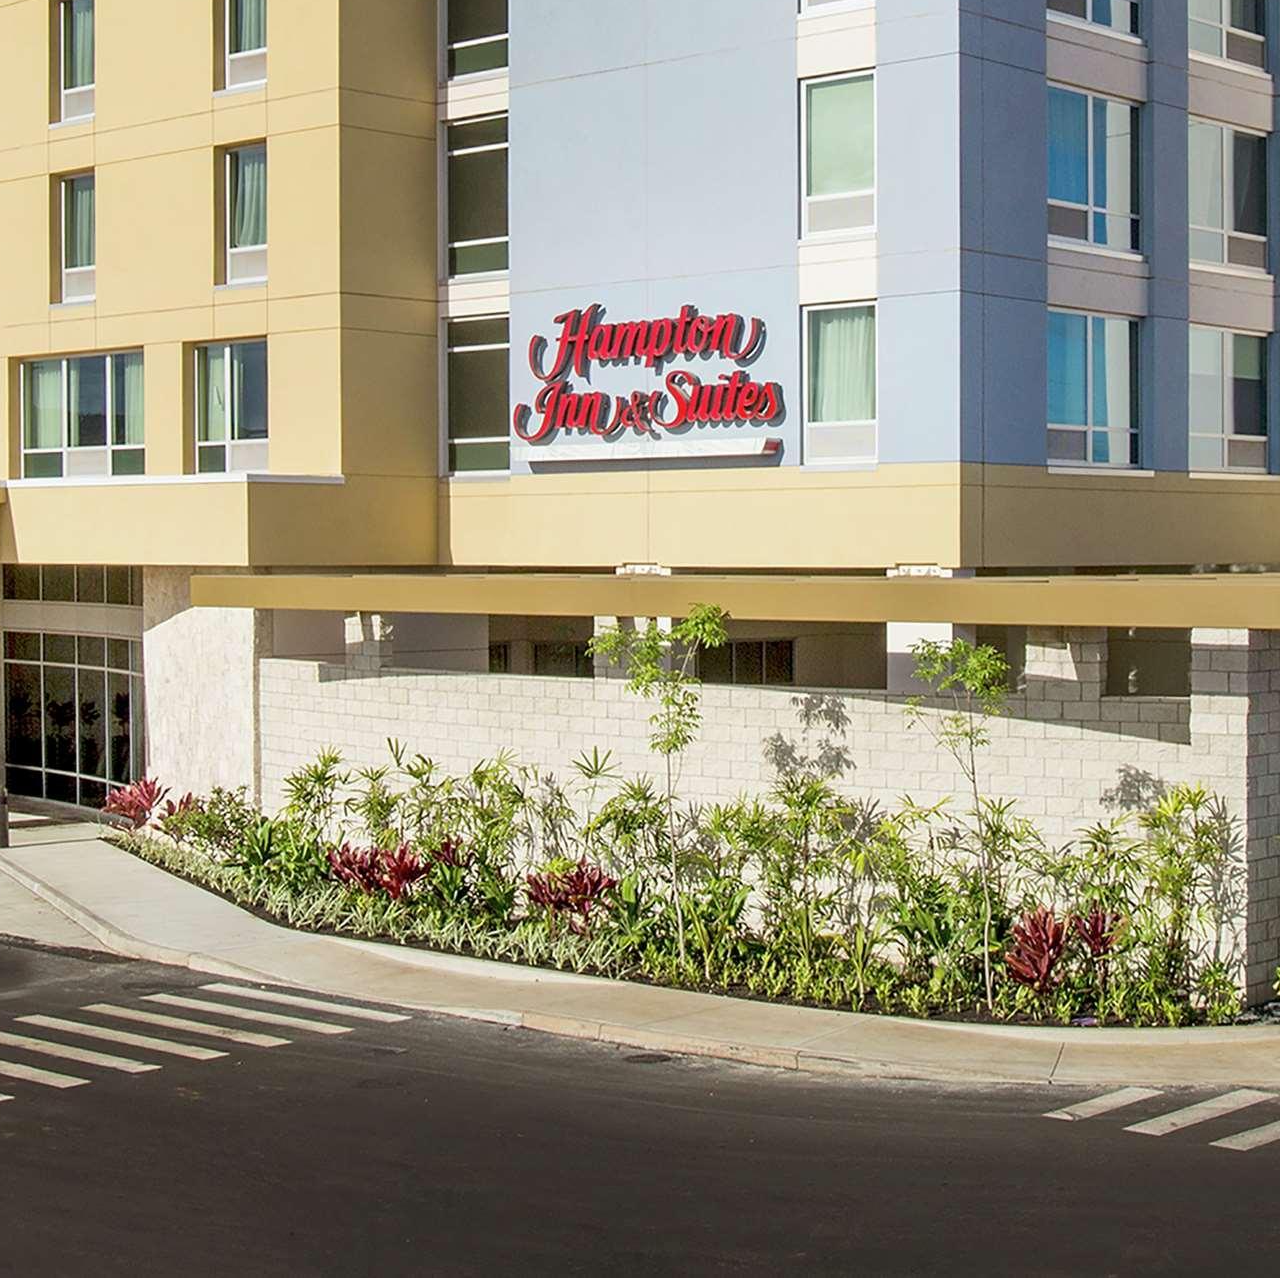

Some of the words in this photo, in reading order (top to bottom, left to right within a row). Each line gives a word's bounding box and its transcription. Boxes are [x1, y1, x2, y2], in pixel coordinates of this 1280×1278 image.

[529, 304, 764, 381] Hampton
[514, 381, 621, 441] Inn
[621, 391, 654, 434] &
[650, 371, 778, 428] Suites
